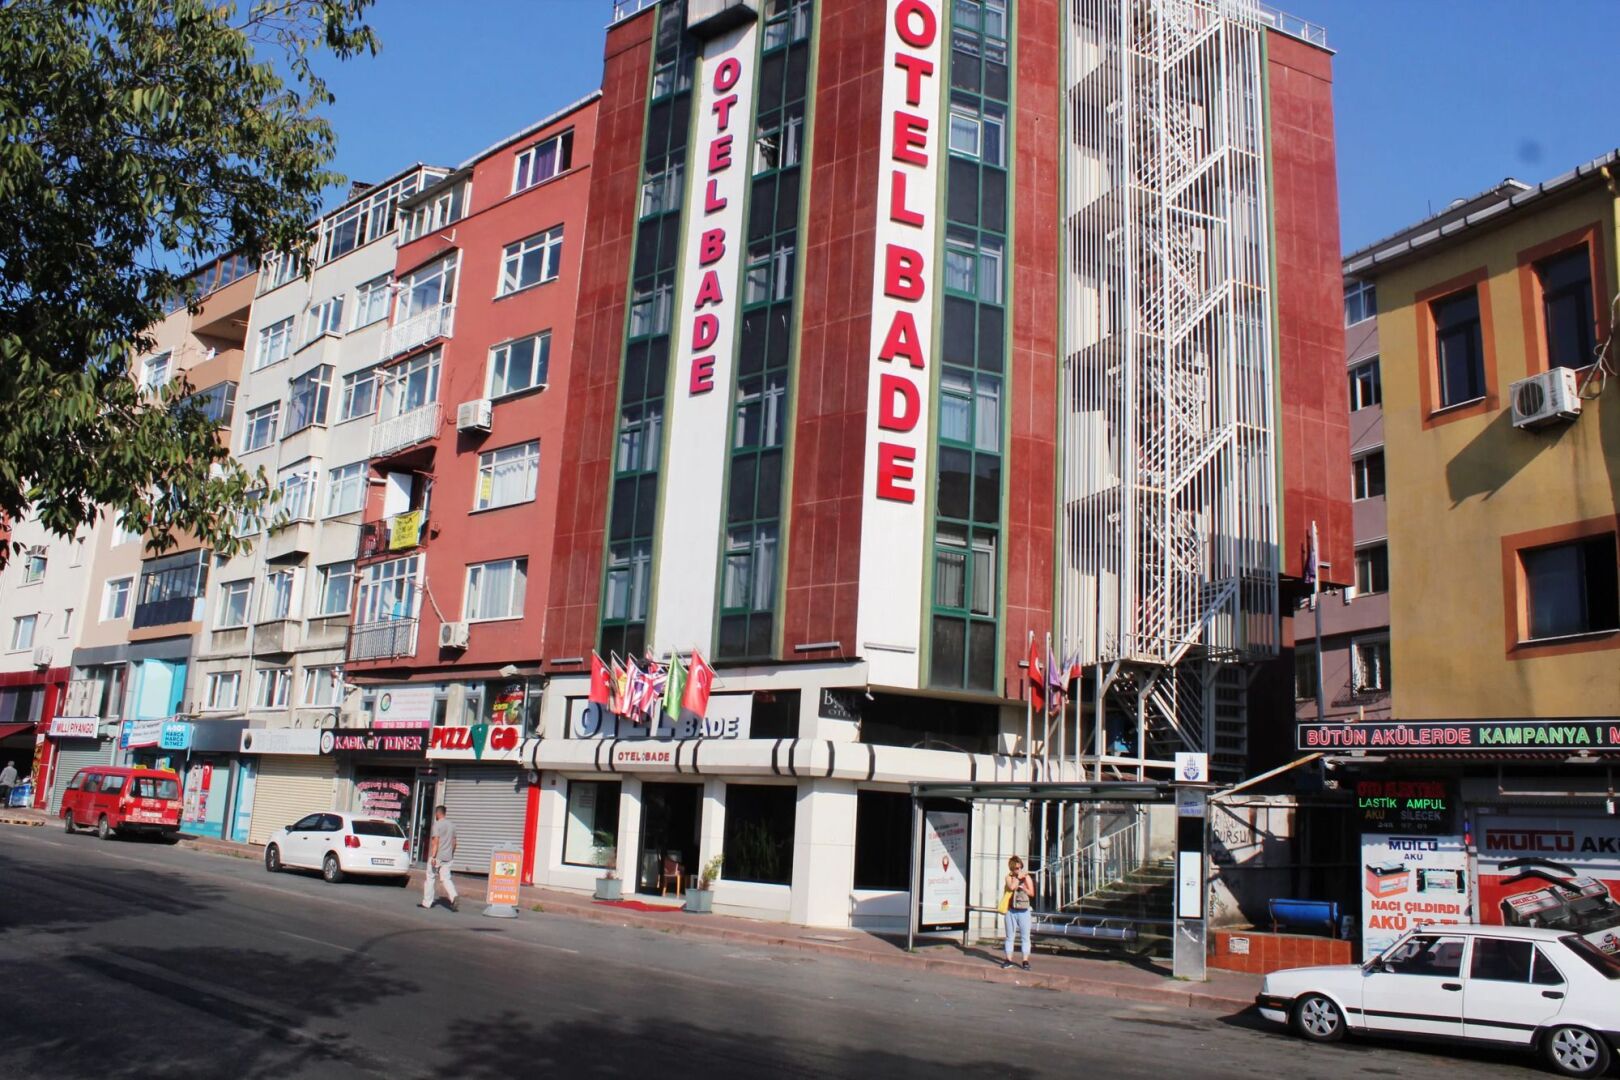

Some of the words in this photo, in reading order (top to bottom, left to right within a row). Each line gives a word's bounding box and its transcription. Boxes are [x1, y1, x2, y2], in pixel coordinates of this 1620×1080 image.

[889, 0, 937, 229] OTEL
[704, 56, 741, 213] OTEL
[689, 227, 726, 397] BADE
[876, 242, 926, 504] BADE
[490, 727, 519, 750] GO
[679, 716, 740, 739] BADE
[1306, 726, 1367, 746] BÜTÜN
[1370, 725, 1472, 745] AKÜLERDE
[1479, 726, 1591, 745] KAMPANYA
[335, 733, 381, 750] KADIKY
[384, 736, 422, 750] TONER
[618, 751, 641, 762] OTEL
[644, 752, 670, 762] BADE
[1358, 797, 1397, 808] LASTİK
[1389, 837, 1438, 851] MUTLU
[1486, 829, 1575, 852] MUTLU
[1580, 836, 1620, 852] AK
[1371, 900, 1401, 911] HACI
[1404, 902, 1460, 915] ÇILDIRDI
[1368, 913, 1407, 930] AKÜ
